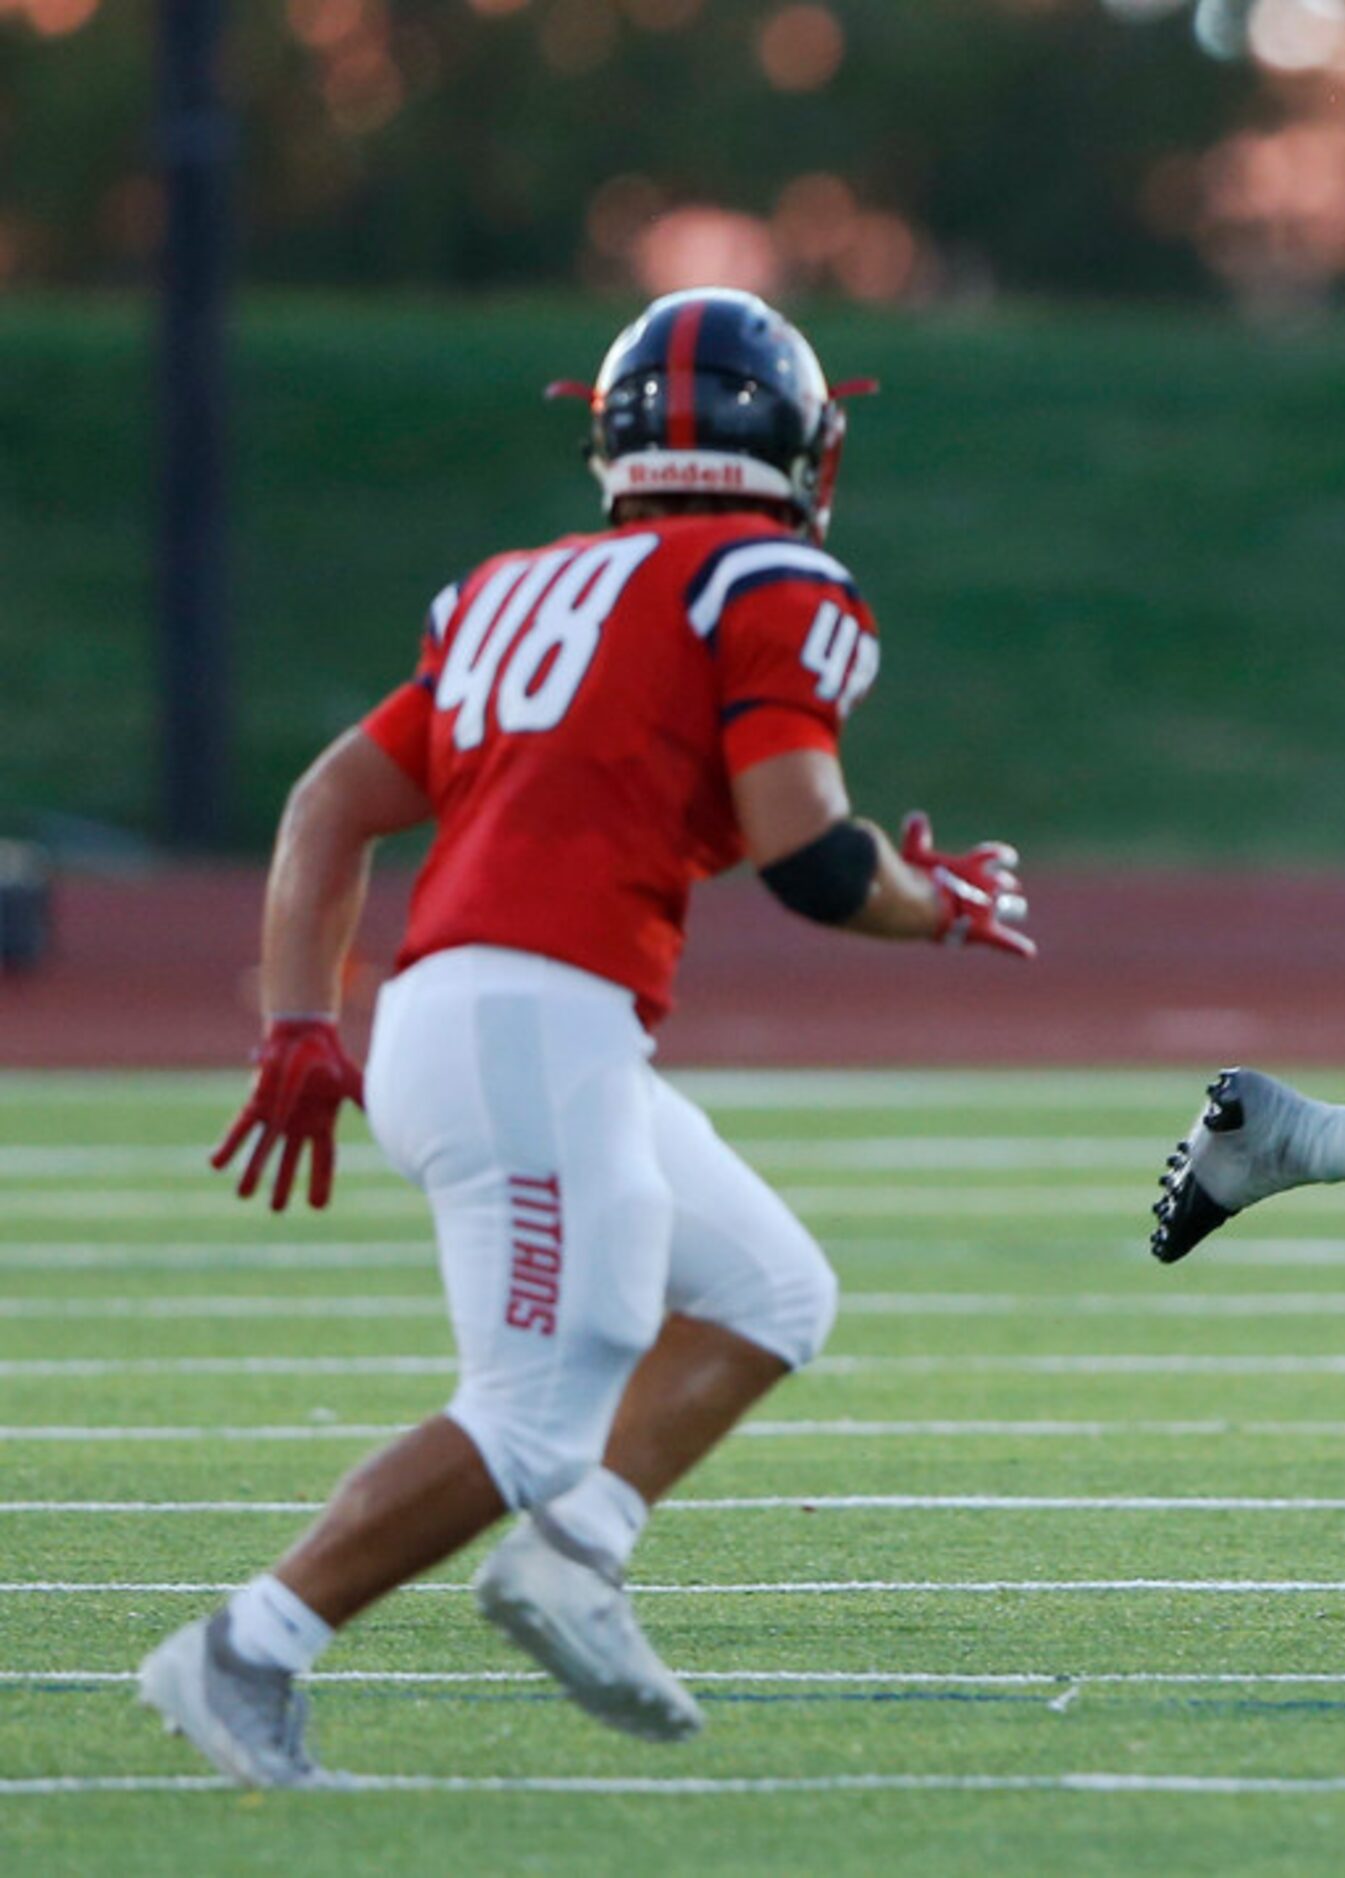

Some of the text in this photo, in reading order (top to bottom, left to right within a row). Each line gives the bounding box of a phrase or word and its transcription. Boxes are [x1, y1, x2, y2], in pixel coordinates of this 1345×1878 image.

[627, 464, 744, 486] Riddell
[434, 531, 660, 753] 48
[505, 1172, 563, 1337] TITANS
